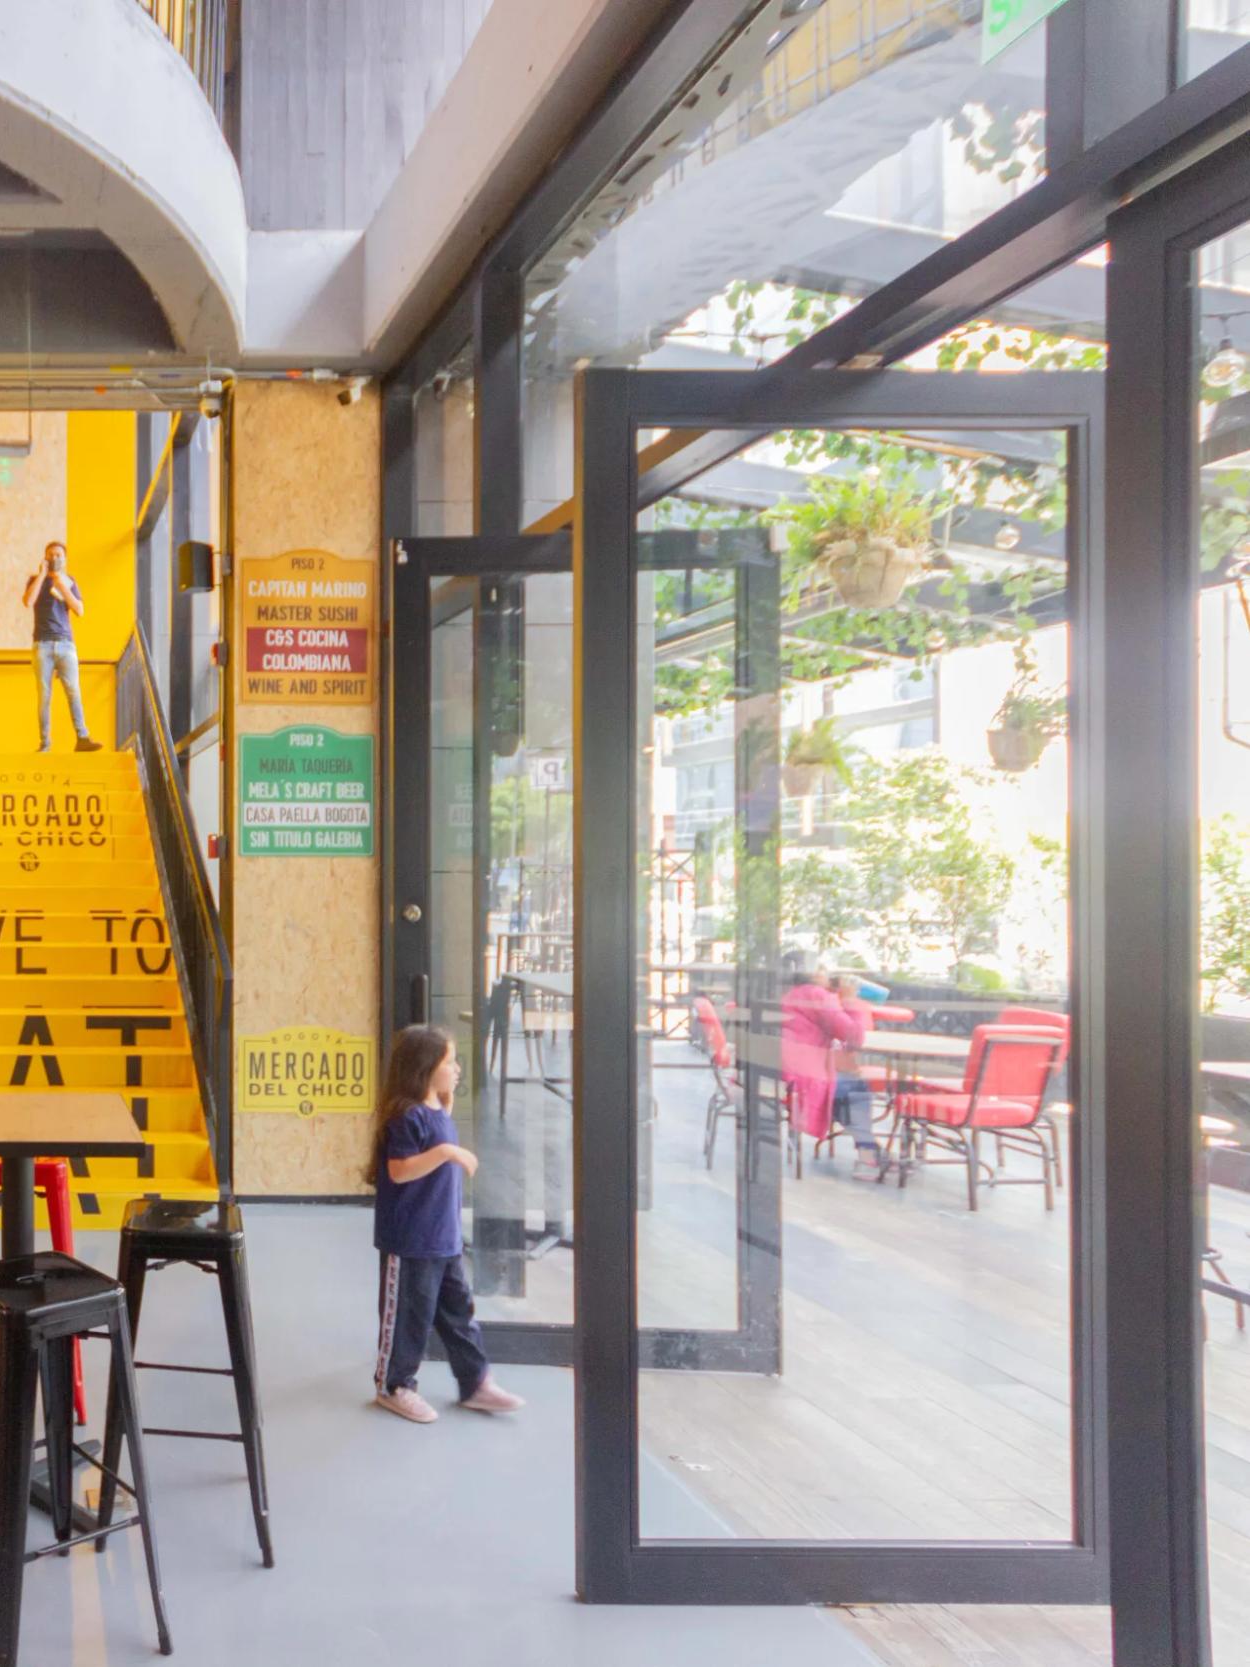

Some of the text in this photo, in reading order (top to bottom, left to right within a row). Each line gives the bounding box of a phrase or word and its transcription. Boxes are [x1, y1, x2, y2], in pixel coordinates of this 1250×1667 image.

[291, 558, 325, 570] PISO 2
[248, 579, 367, 598] CAPITAN MARINO
[257, 605, 358, 622] MASTER SUSHI
[265, 629, 349, 647] C&S COCINA
[262, 653, 352, 672] COLOMBIANA
[248, 678, 367, 696] WINE AND SPIRIT
[289, 733, 324, 747] PISO 2
[296, 781, 333, 799] CRAFT
[336, 781, 365, 799] BEER
[246, 806, 368, 823] CASA PAELLA BOGOTA
[250, 831, 363, 848] SIN TITULO GALERIA
[88, 908, 172, 982] TO
[249, 1051, 364, 1080] MERCADO
[249, 1083, 287, 1096] DEL
